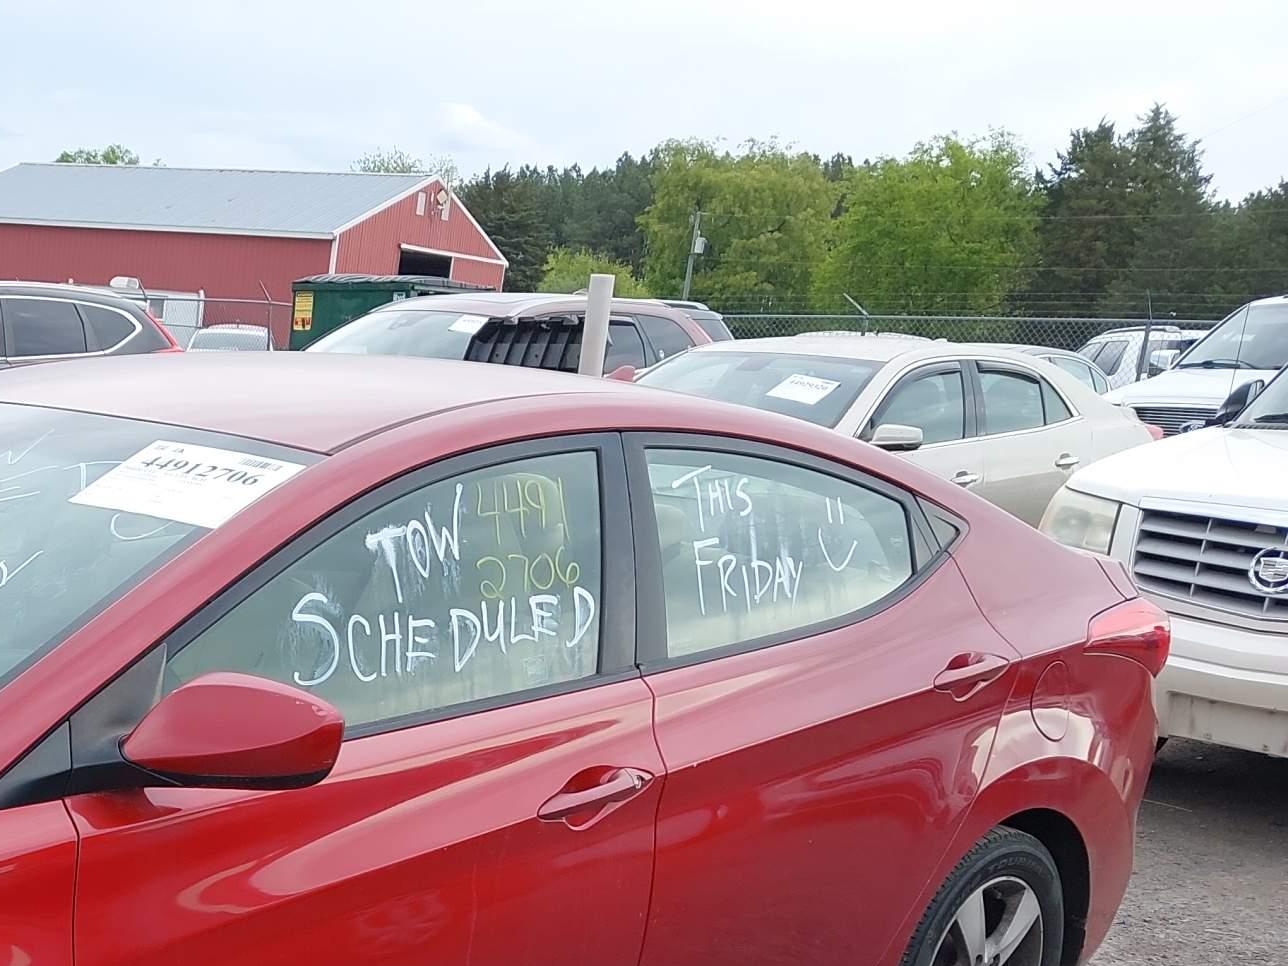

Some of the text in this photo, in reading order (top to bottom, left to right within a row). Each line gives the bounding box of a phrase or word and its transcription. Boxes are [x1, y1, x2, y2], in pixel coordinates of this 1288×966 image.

[141, 456, 264, 486] 44912706
[672, 465, 753, 533] THIS
[365, 483, 463, 603] TOW
[476, 476, 569, 545] 4491
[476, 545, 580, 599] 2706
[693, 537, 803, 616] FRIDAY
[292, 586, 595, 686] SCHEDULED
